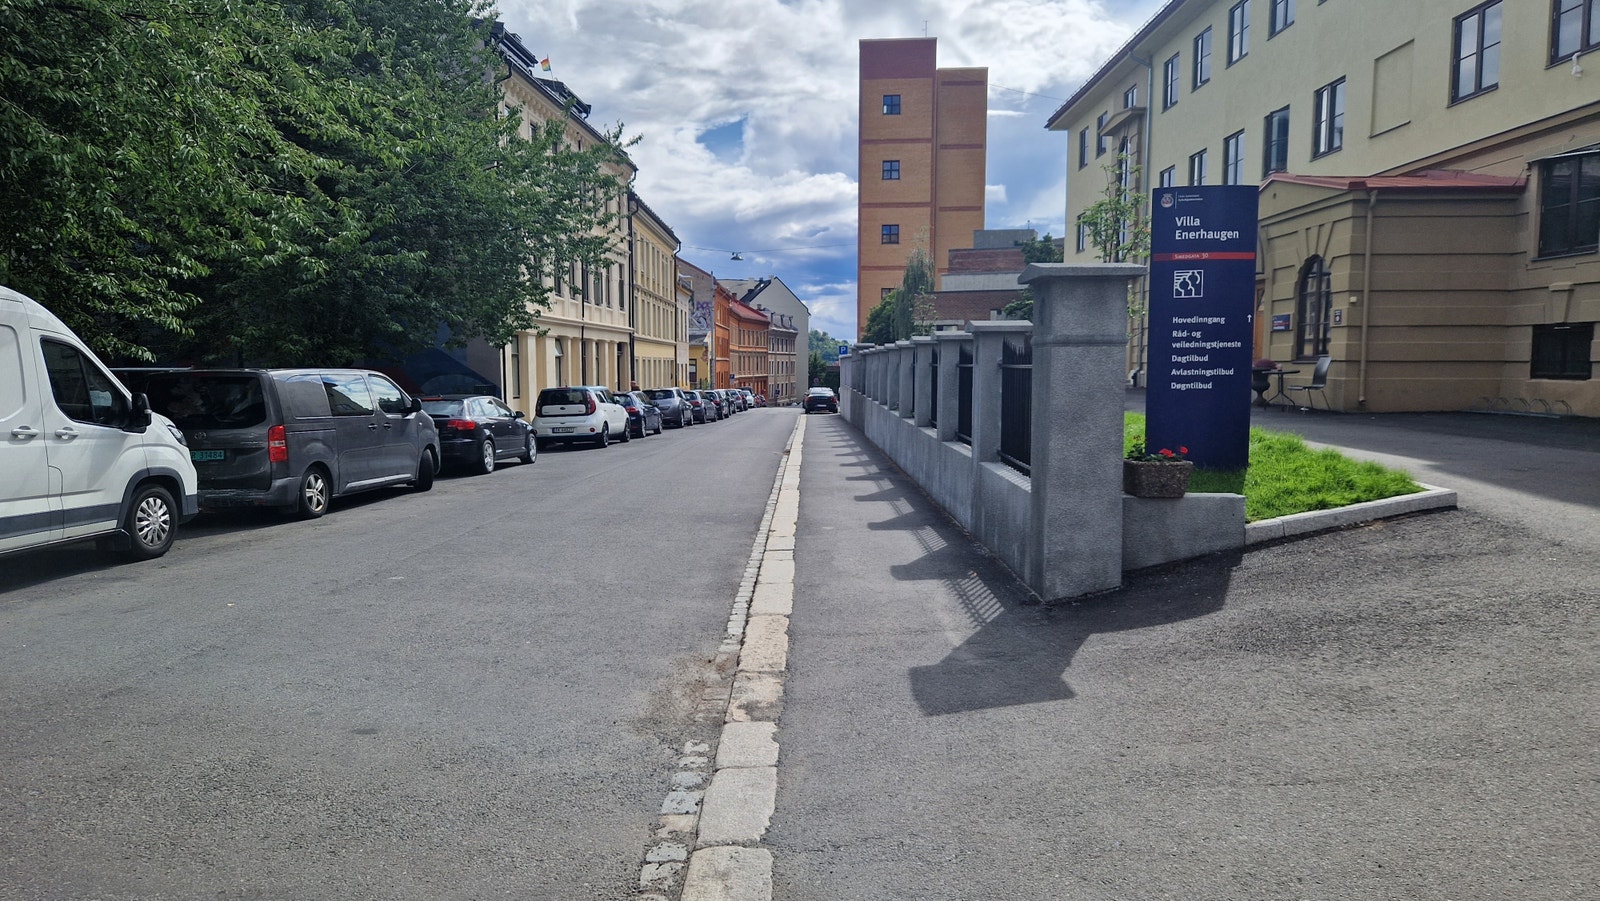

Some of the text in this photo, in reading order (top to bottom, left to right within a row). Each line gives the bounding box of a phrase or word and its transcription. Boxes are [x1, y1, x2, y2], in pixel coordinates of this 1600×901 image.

[1175, 215, 1200, 227] Villa
[1175, 228, 1239, 241] Enerhaugen
[1201, 252, 1209, 260] 30
[1172, 316, 1226, 325] Hovedinngang
[1172, 329, 1202, 339] Råd- og
[1171, 340, 1242, 350] veiledningstjeneste
[841, 346, 846, 354] P
[1171, 354, 1209, 363] Dagtilbud
[1170, 367, 1234, 376] Avlastningstilbud
[1170, 381, 1213, 391] Døgntilbud
